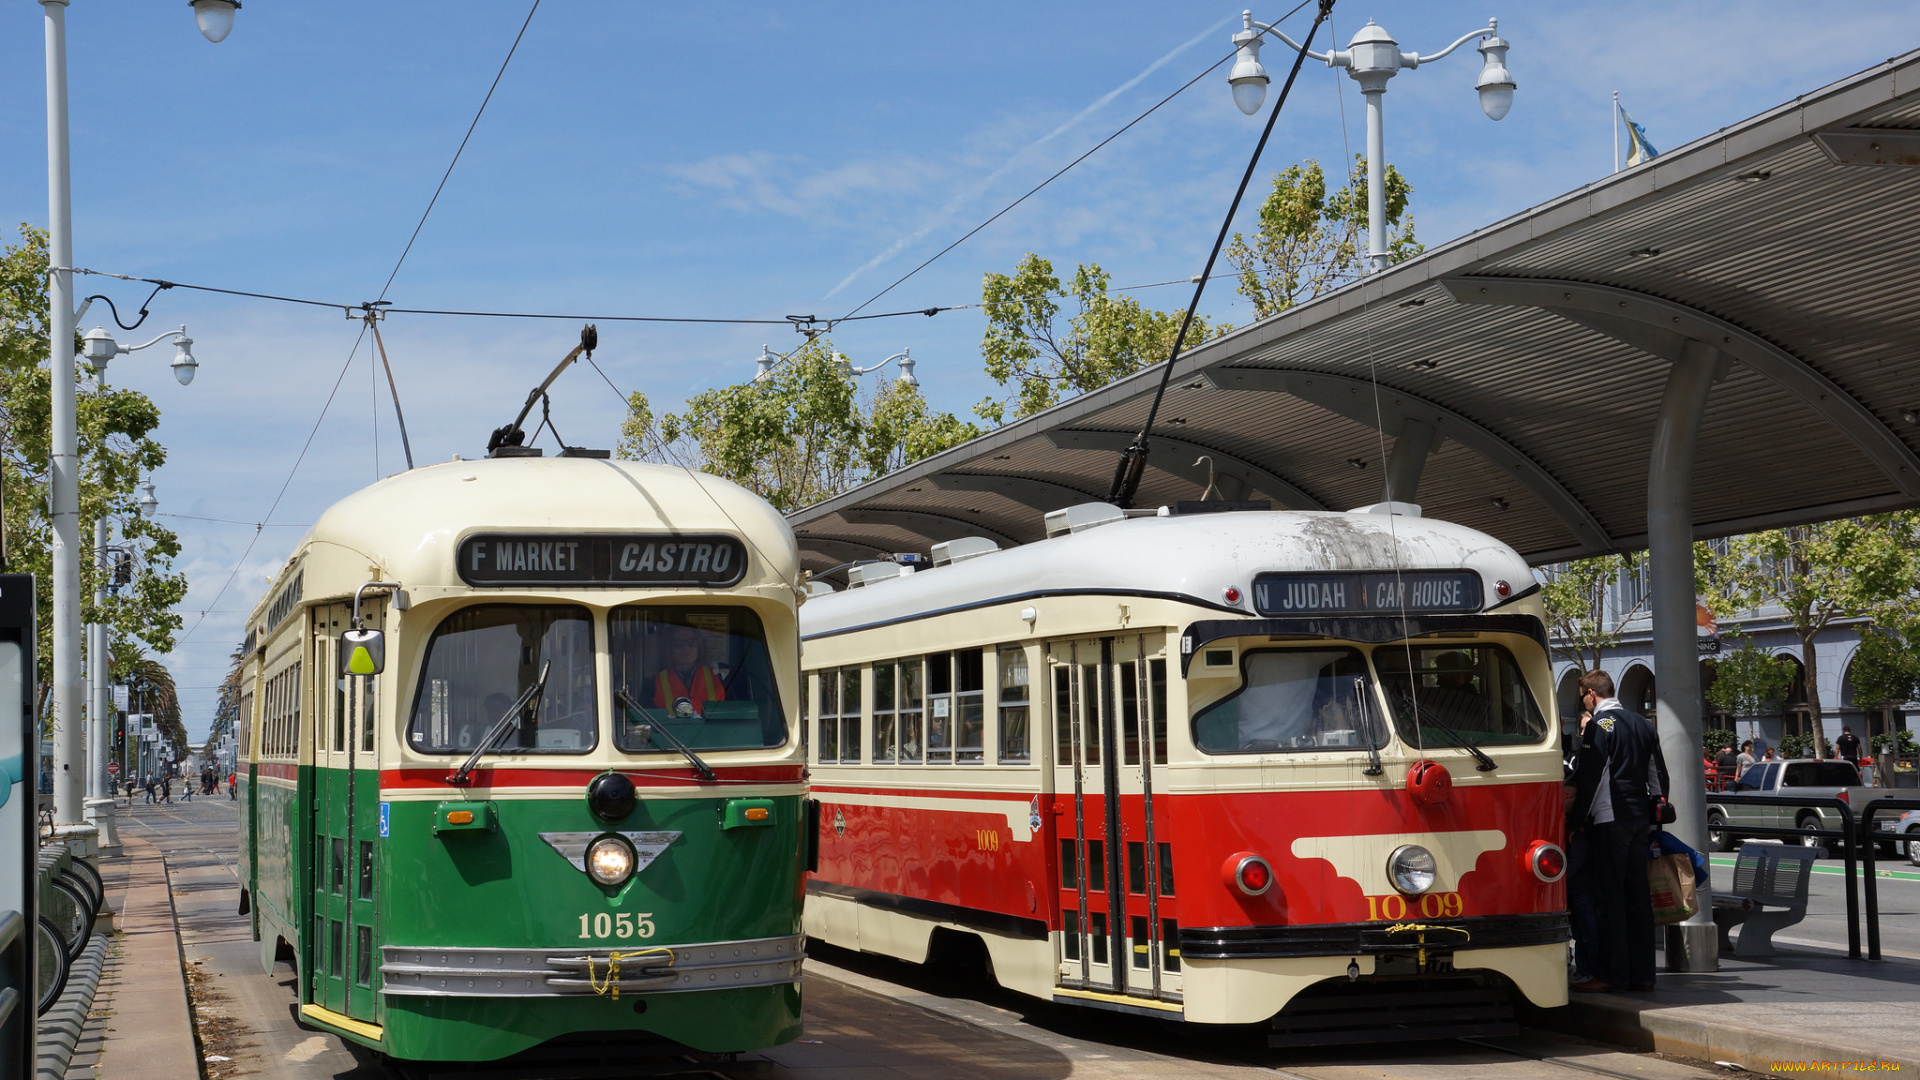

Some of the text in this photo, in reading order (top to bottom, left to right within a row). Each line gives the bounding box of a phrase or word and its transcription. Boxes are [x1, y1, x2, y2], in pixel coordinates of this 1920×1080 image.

[472, 541, 732, 573] F MARKET CASTRO
[1255, 580, 1461, 610] N JUDAH CAR HOUSE
[977, 829, 999, 851] 1009
[578, 912, 656, 939] 1055
